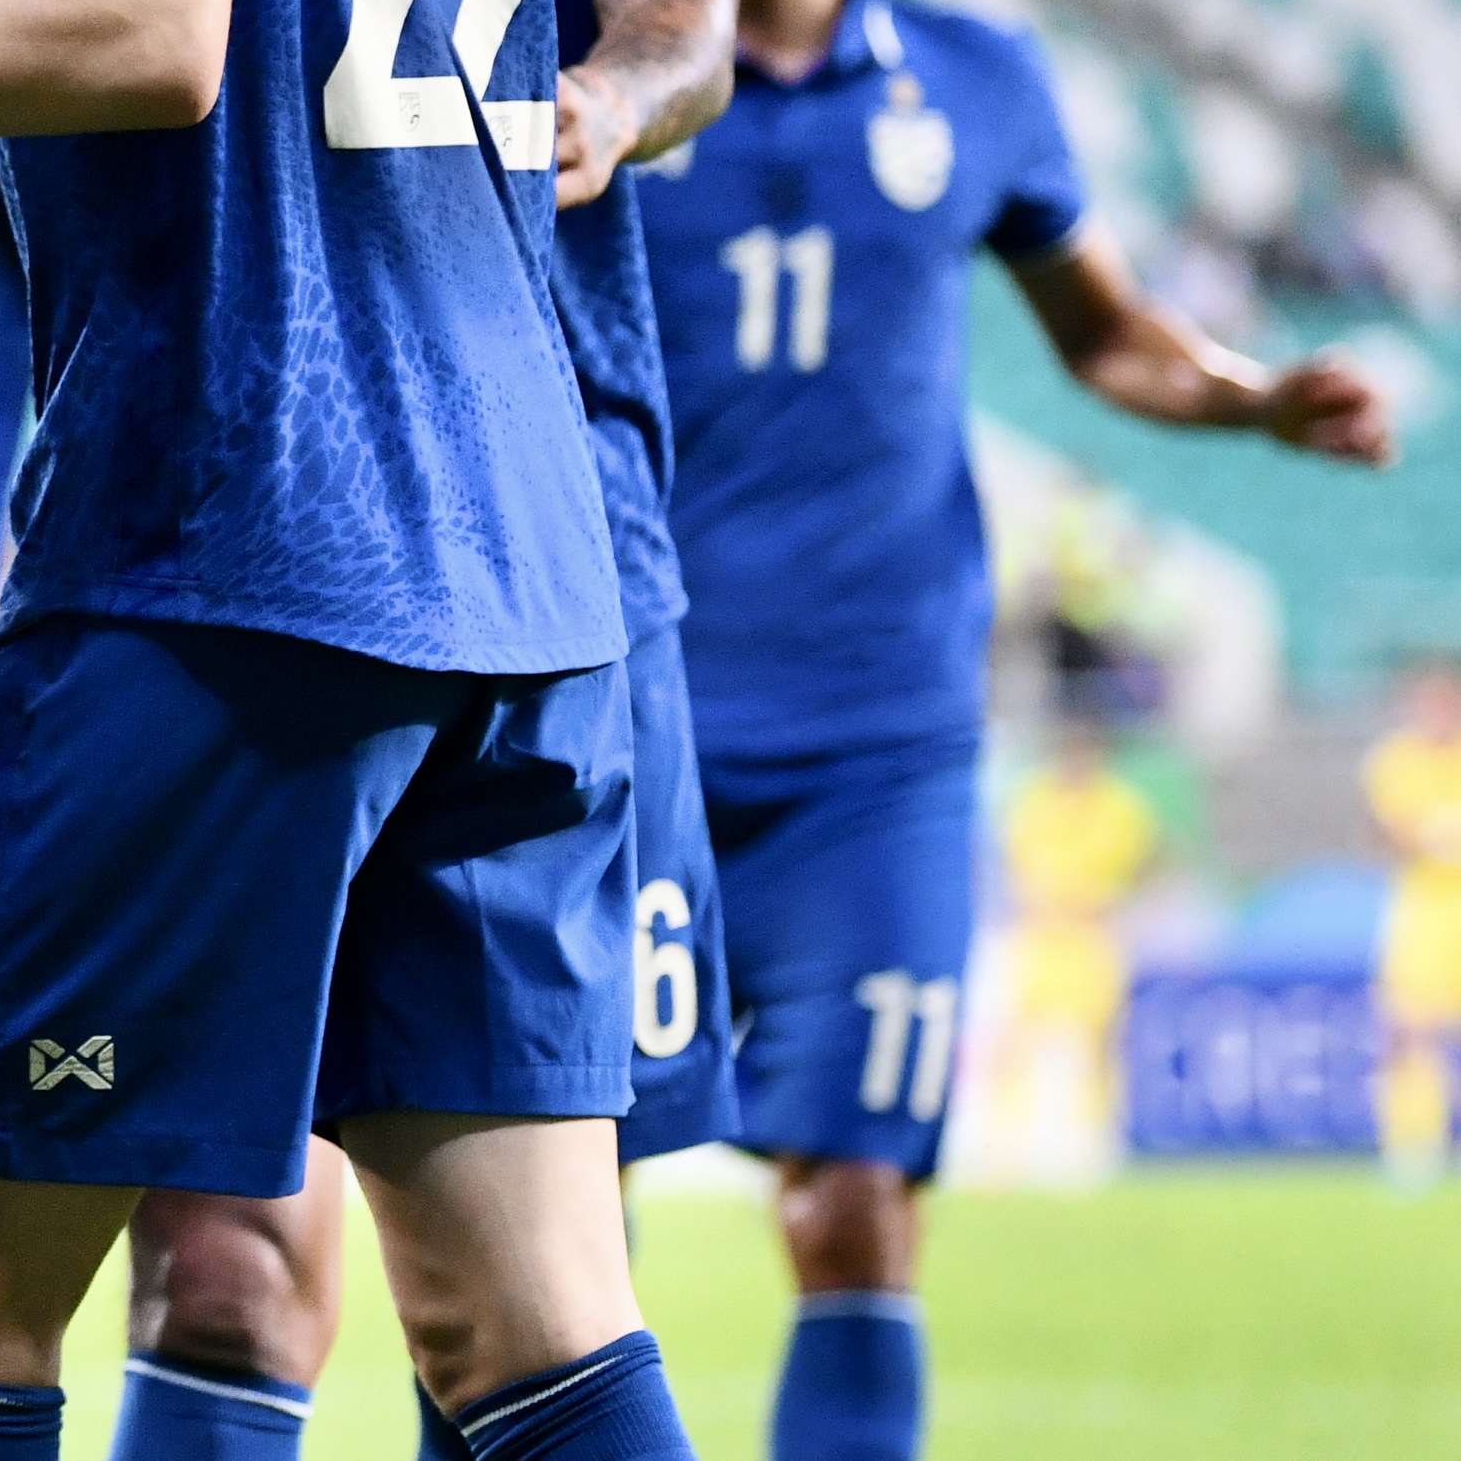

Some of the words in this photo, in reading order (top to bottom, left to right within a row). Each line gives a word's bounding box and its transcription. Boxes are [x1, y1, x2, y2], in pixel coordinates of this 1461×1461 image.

[719, 225, 835, 373] 11
[633, 877, 698, 1060] 6
[854, 969, 960, 1124] 11
